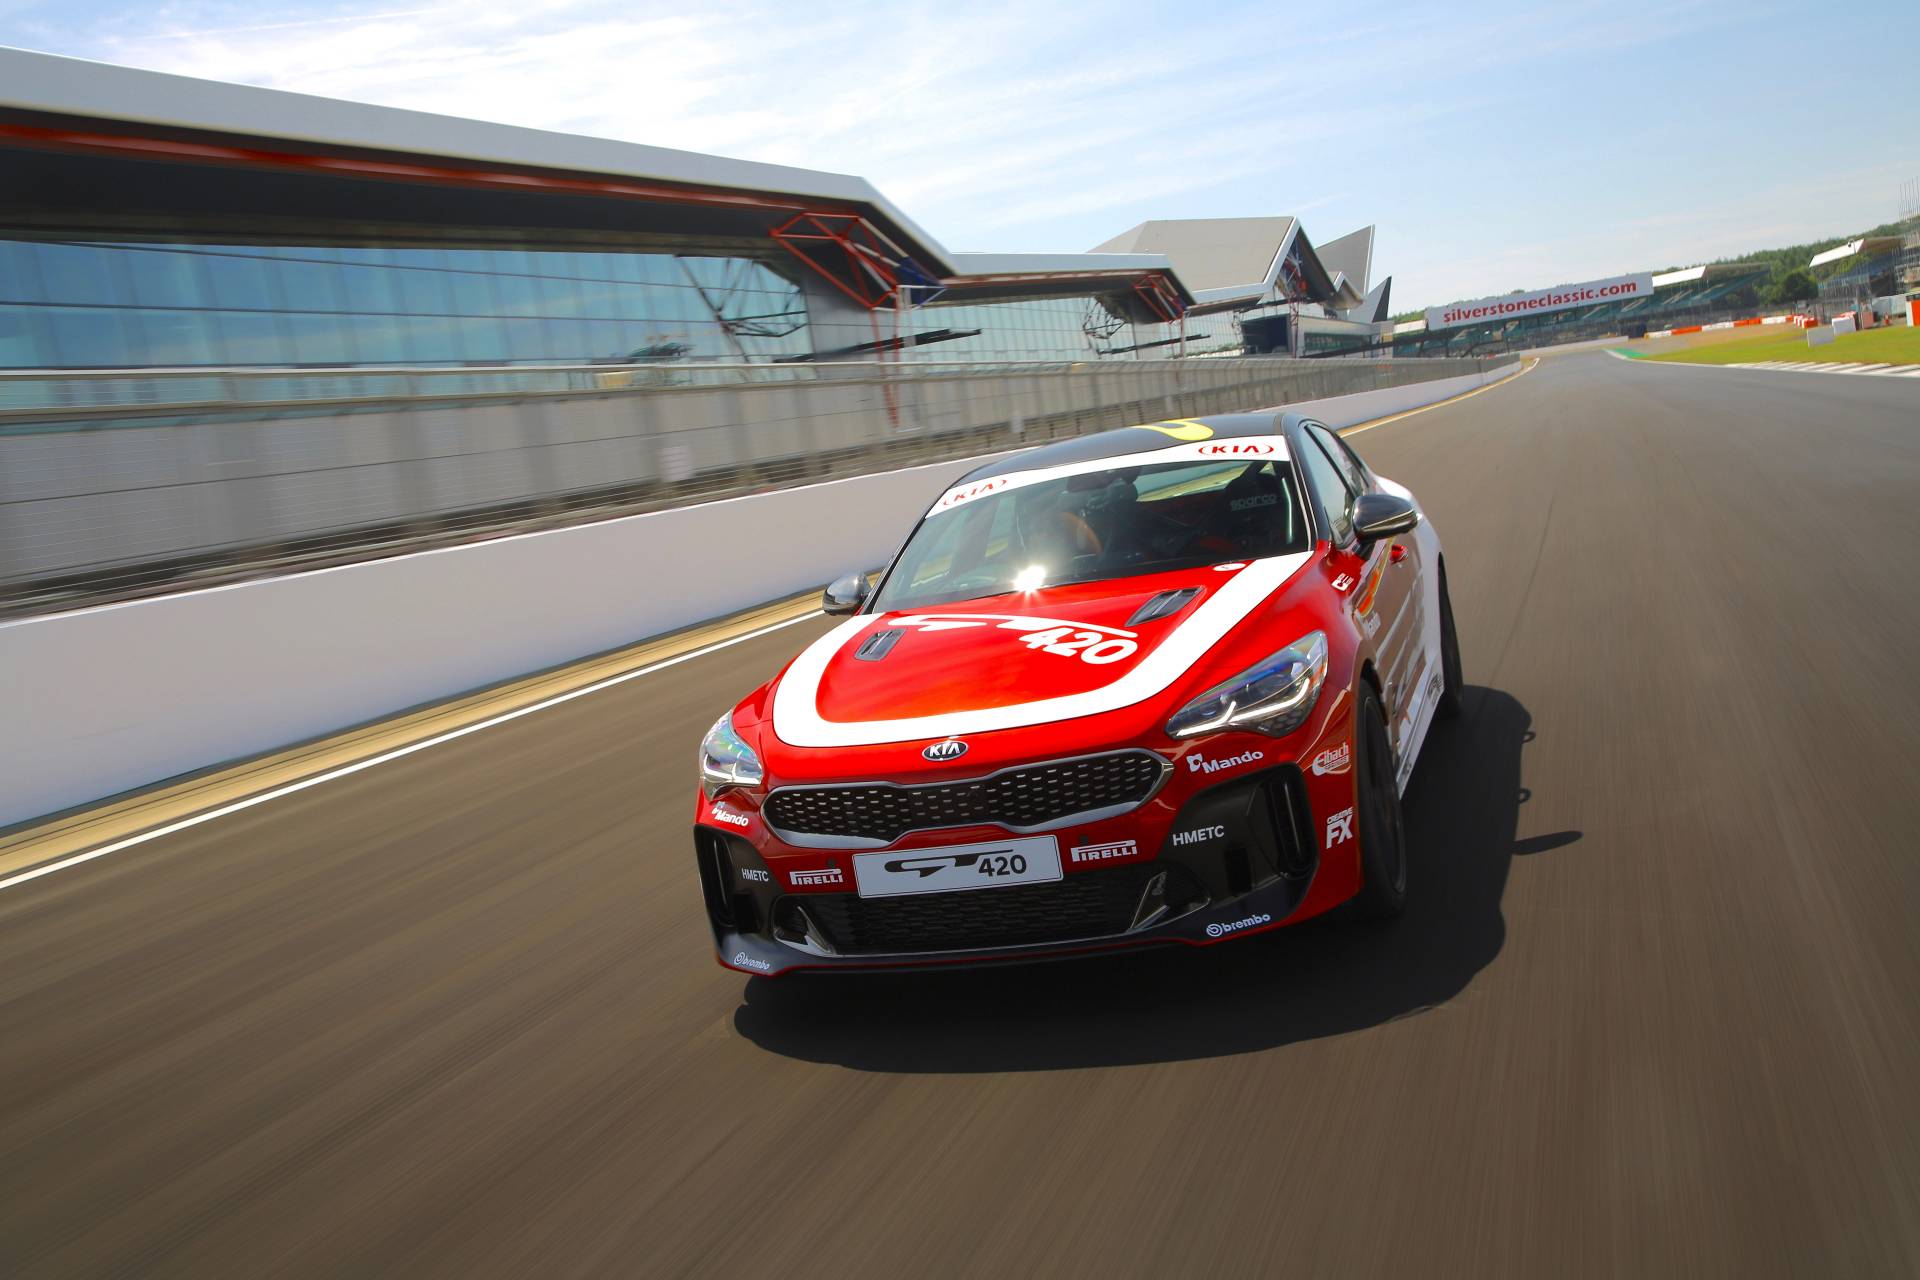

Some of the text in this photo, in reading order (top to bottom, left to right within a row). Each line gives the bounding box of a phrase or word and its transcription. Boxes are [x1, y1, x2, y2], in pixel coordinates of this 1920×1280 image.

[1443, 279, 1638, 323] silverstoneclassic.com
[1210, 444, 1260, 455] KIA
[1019, 625, 1138, 664] 420
[927, 741, 963, 760] KIA
[1203, 751, 1264, 774] Mando
[714, 809, 749, 827] Mando
[1172, 825, 1225, 846] HMETC
[1326, 814, 1353, 849] FX
[1071, 840, 1137, 862] PIRELLI
[741, 868, 769, 882] HMETC
[978, 854, 1027, 877] 420
[789, 868, 843, 885] PIRELLI
[1221, 914, 1271, 932] brembo
[741, 956, 770, 970] brembo
